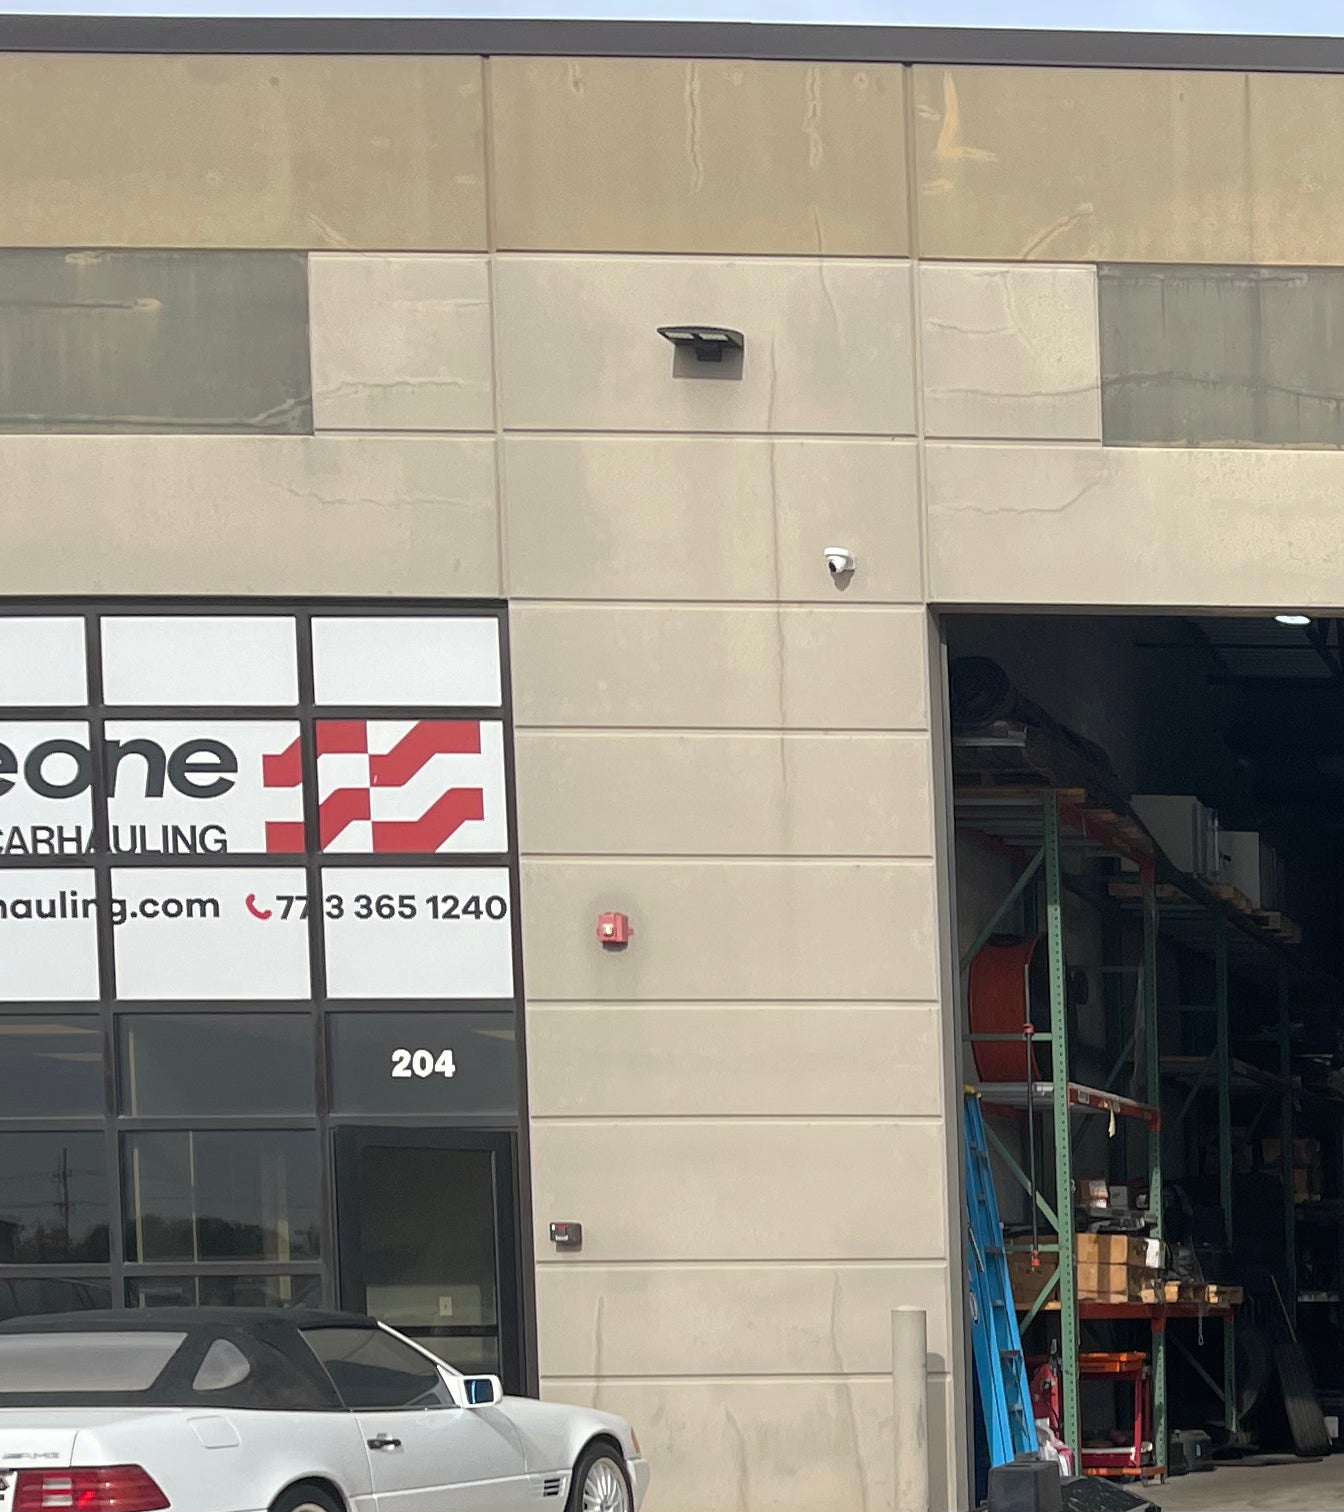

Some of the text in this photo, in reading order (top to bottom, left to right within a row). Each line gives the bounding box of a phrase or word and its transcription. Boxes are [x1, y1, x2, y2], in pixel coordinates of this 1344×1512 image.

[0, 738, 238, 799] one
[0, 824, 228, 855] ARHULING
[276, 894, 508, 920] 773 365 1240
[391, 1048, 456, 1078] 204
